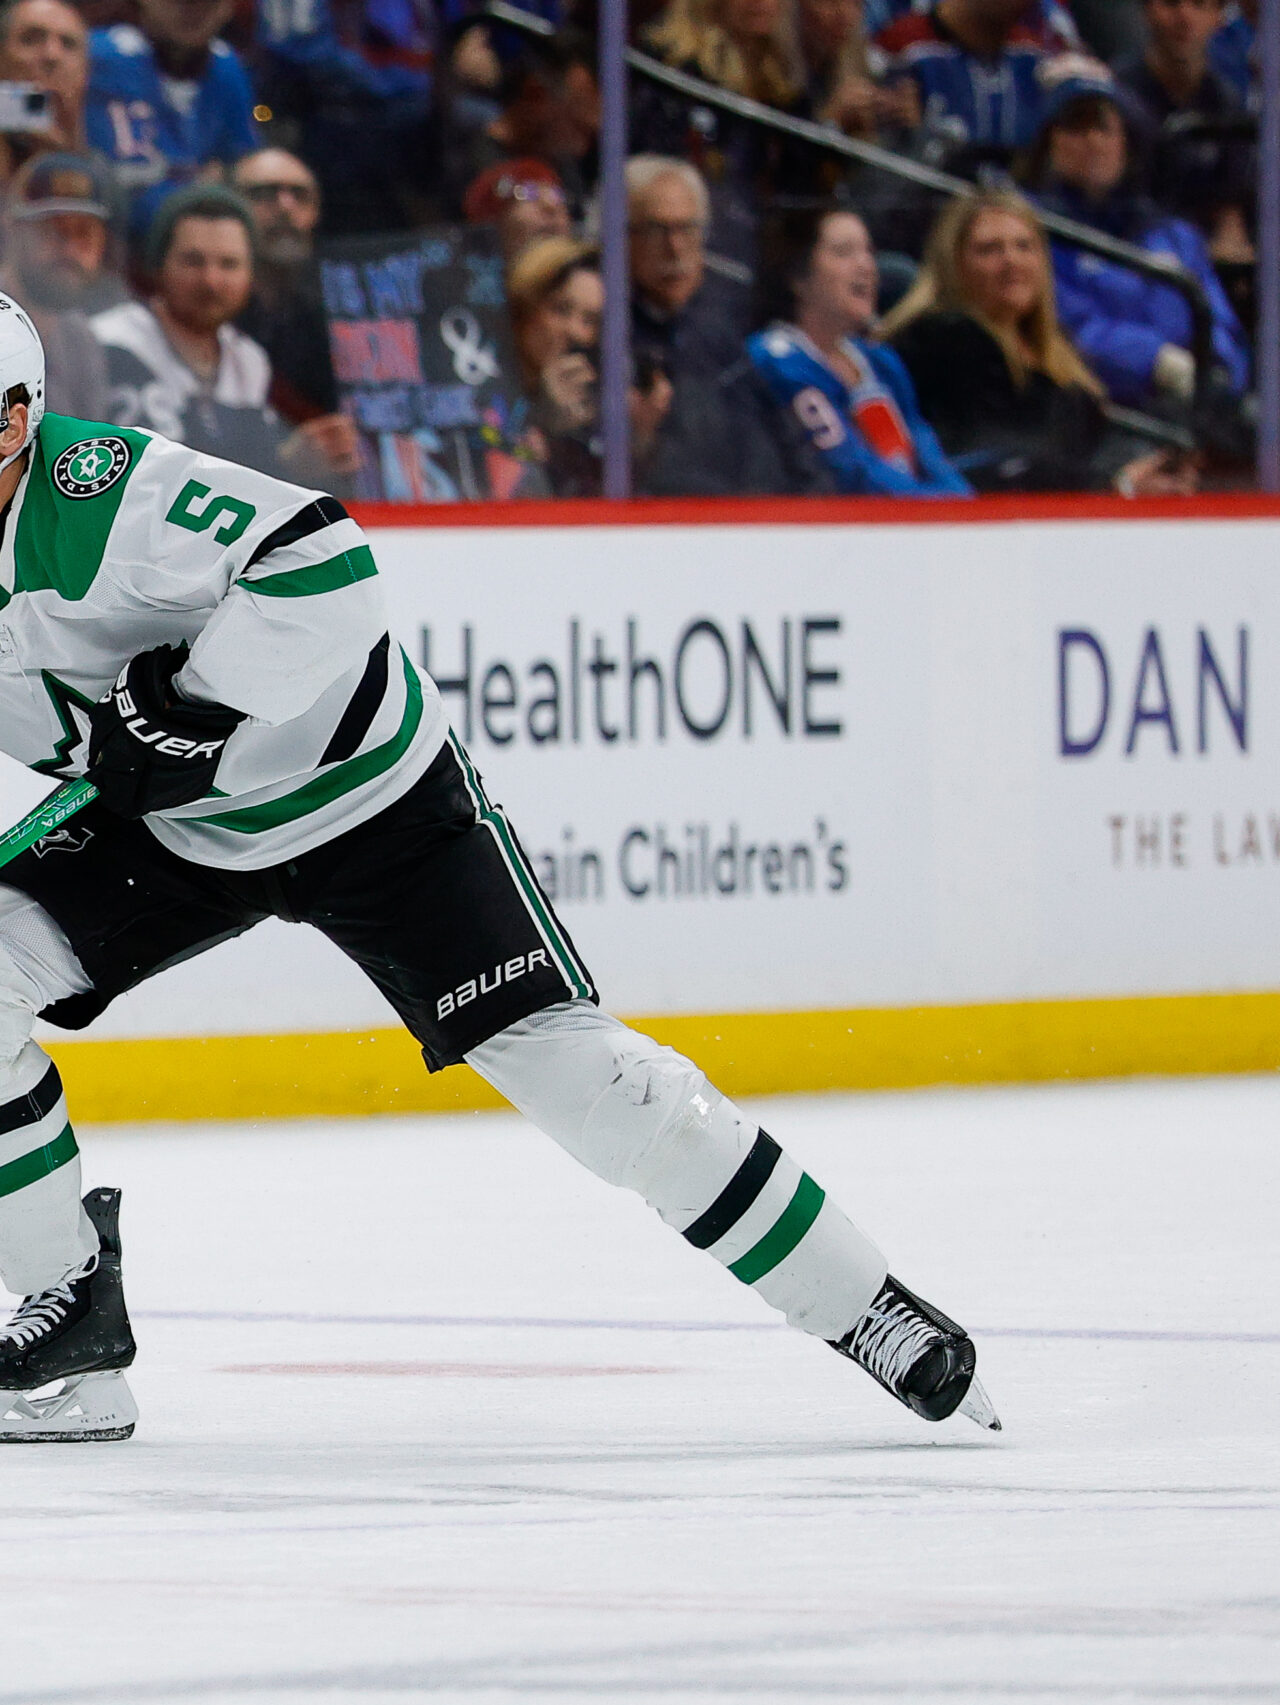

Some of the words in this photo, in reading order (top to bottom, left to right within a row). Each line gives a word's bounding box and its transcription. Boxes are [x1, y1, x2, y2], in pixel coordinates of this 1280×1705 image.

[793, 387, 846, 450] 9
[58, 440, 99, 491] DALLAS
[91, 443, 124, 491] STARS
[165, 478, 257, 547] 5
[420, 616, 844, 746] HealthONE
[1057, 626, 1250, 758] DAN
[522, 825, 604, 903] ain
[620, 817, 848, 897] Children's
[1108, 812, 1187, 868] THE
